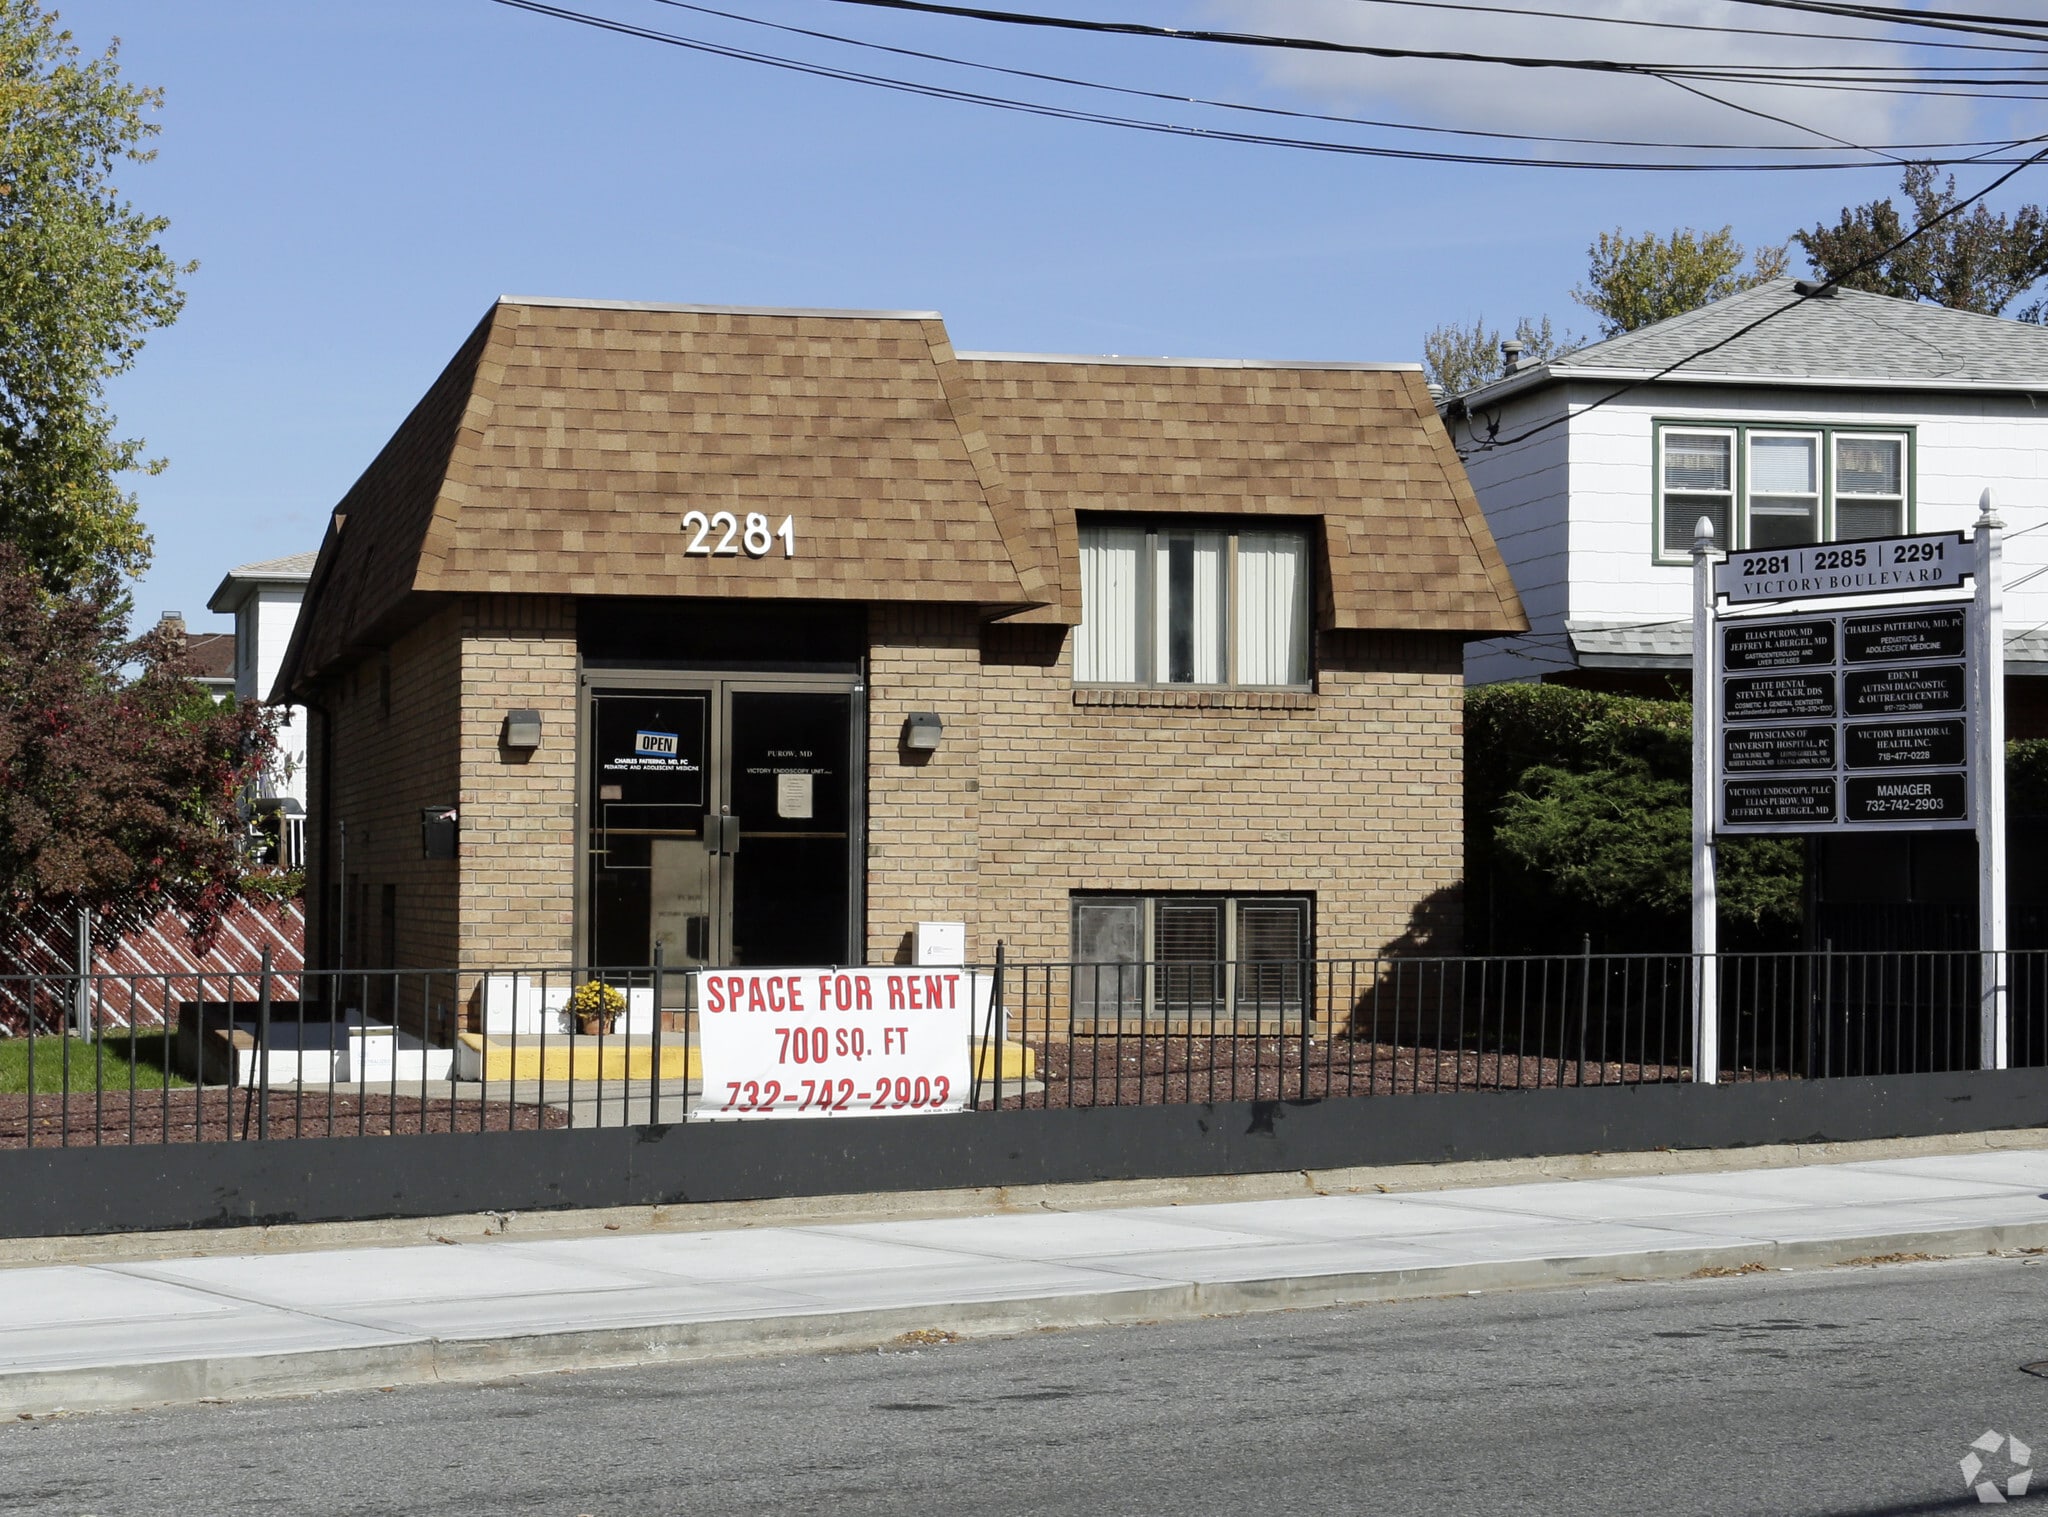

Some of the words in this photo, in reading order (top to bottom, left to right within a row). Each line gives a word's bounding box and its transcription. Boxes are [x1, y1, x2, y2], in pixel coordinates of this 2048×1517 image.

[682, 510, 794, 556] 2281
[1743, 555, 1790, 576] 2281
[1814, 549, 1867, 570] 2285
[1893, 542, 1944, 564] 2291
[1744, 577, 1824, 595] VICTORY
[1830, 567, 1943, 589] BOULEVARD
[1844, 624, 1882, 634] CHARLES
[1883, 621, 1931, 632] PATTERINO,
[1952, 618, 1963, 627] PC
[1745, 631, 1768, 640] ELIAS
[1800, 627, 1813, 636] MD
[1880, 635, 1917, 644] PEDIATRICS
[1730, 642, 1763, 651] JEFFREY
[1765, 641, 1772, 649] R.
[1814, 637, 1828, 645] MD
[1865, 644, 1908, 654] ADOLESCENT
[1909, 641, 1941, 651] MEDICINE
[1745, 650, 1800, 660] GASTROENTEROLOGY
[1774, 657, 1800, 665] DISEASES
[1887, 671, 1911, 680] EDEN
[1751, 682, 1774, 690] ELITE
[1775, 680, 1807, 689] DENTAL
[1861, 683, 1893, 693] AUTISM
[1894, 680, 1947, 691] DIAGNOSTIC
[1735, 690, 1766, 700] STEVEN
[1806, 687, 1823, 696] DDS
[1858, 695, 1865, 704] &
[1866, 693, 1913, 703] OUTREACH
[1914, 690, 1949, 700] CENTER
[1794, 698, 1824, 706] DENTISTRY
[1749, 730, 1796, 740] PHYSICIANS
[1796, 729, 1808, 738] OF
[1857, 729, 1895, 739] VICTORY
[1896, 727, 1951, 737] BEHAVIORAL
[642, 735, 673, 752] OPEN
[1728, 741, 1774, 751] UNIVERSITY
[1818, 739, 1830, 747] PC
[1914, 738, 1932, 747] INC.
[799, 750, 813, 758] MD
[1878, 751, 1930, 760] 718-477-0228
[1729, 788, 1761, 797] VICTORY
[1811, 785, 1832, 794] PLLC
[1877, 783, 1932, 796] MANAGER
[1745, 798, 1768, 806] ELIAS
[1802, 796, 1815, 805] MD
[1865, 798, 1944, 811] 732-742-2903
[1731, 808, 1763, 816] JEFFREY
[1815, 806, 1829, 814] MD
[707, 976, 804, 1013] SPACE
[818, 974, 873, 1011] FOR
[887, 974, 960, 1010] RENT
[775, 1026, 829, 1064] 700
[835, 1027, 872, 1061] SQ.
[884, 1027, 909, 1055] FT
[720, 1075, 951, 1113] 732-742-2903
